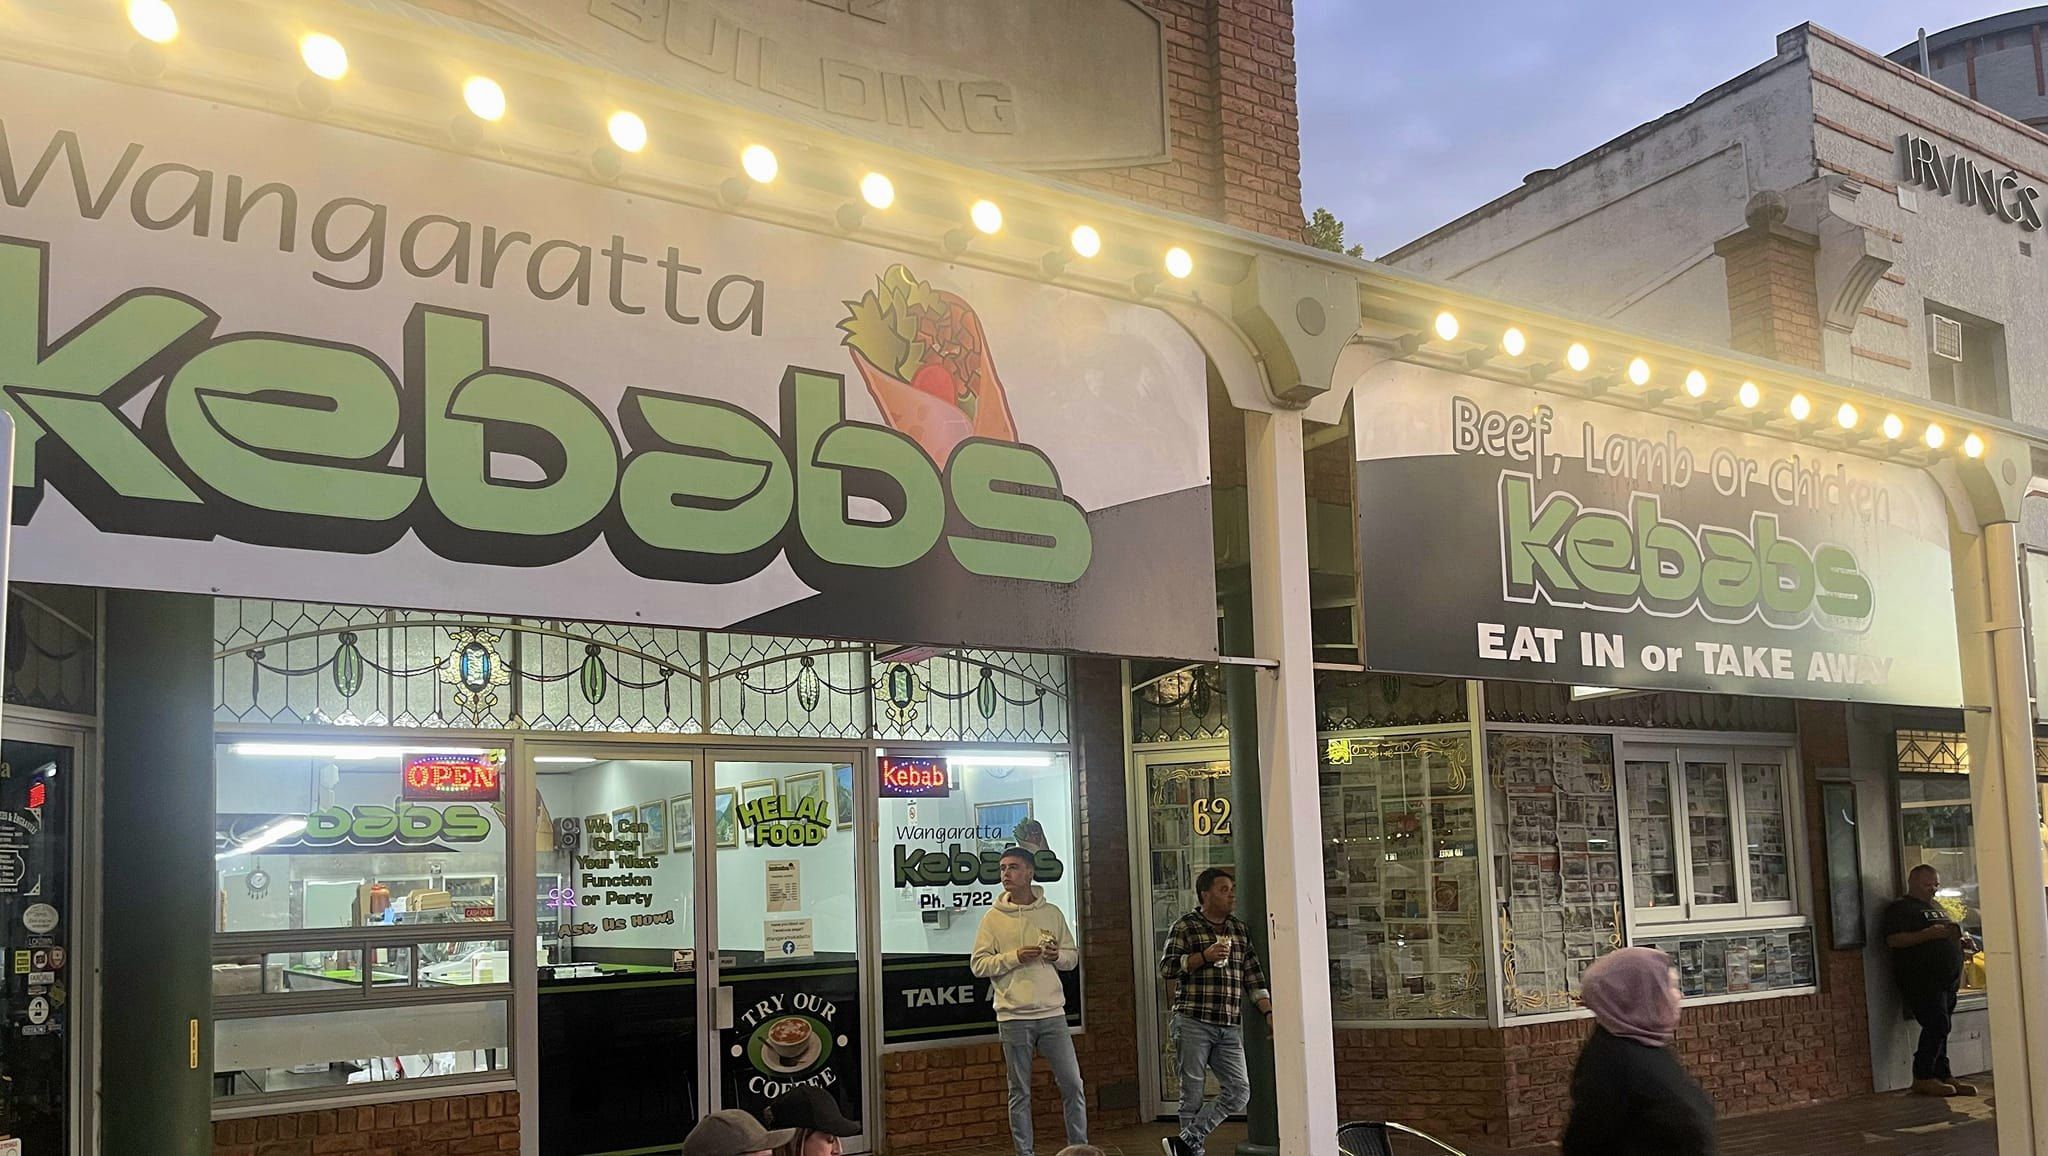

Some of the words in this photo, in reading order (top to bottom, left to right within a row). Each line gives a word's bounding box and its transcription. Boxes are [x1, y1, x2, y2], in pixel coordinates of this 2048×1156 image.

[0, 117, 764, 337] Wangaratta
[1582, 421, 1694, 488] Lamb
[1477, 622, 1563, 664] EAT
[1580, 632, 1625, 668] IN
[1640, 644, 1683, 672] or
[1695, 641, 1796, 680] TAKE
[1807, 651, 1896, 685] AWAY
[407, 766, 495, 788] OPEN
[736, 795, 832, 829] HELAL
[1192, 798, 1232, 837] 62
[584, 818, 612, 834] We
[618, 818, 649, 834] Can
[754, 822, 825, 848] FOOD
[897, 825, 1002, 844] Wangaratta
[593, 836, 641, 852] Cater
[576, 855, 614, 870] Your
[618, 854, 659, 869] Next
[582, 872, 652, 889] Function
[581, 894, 600, 906] or
[606, 891, 653, 908] Party
[920, 893, 945, 909] Ph.
[953, 891, 993, 908] 5722
[558, 921, 598, 939] Ask
[902, 984, 974, 1008] TAKE
[741, 993, 785, 1027] TRY
[793, 992, 837, 1023] OUR
